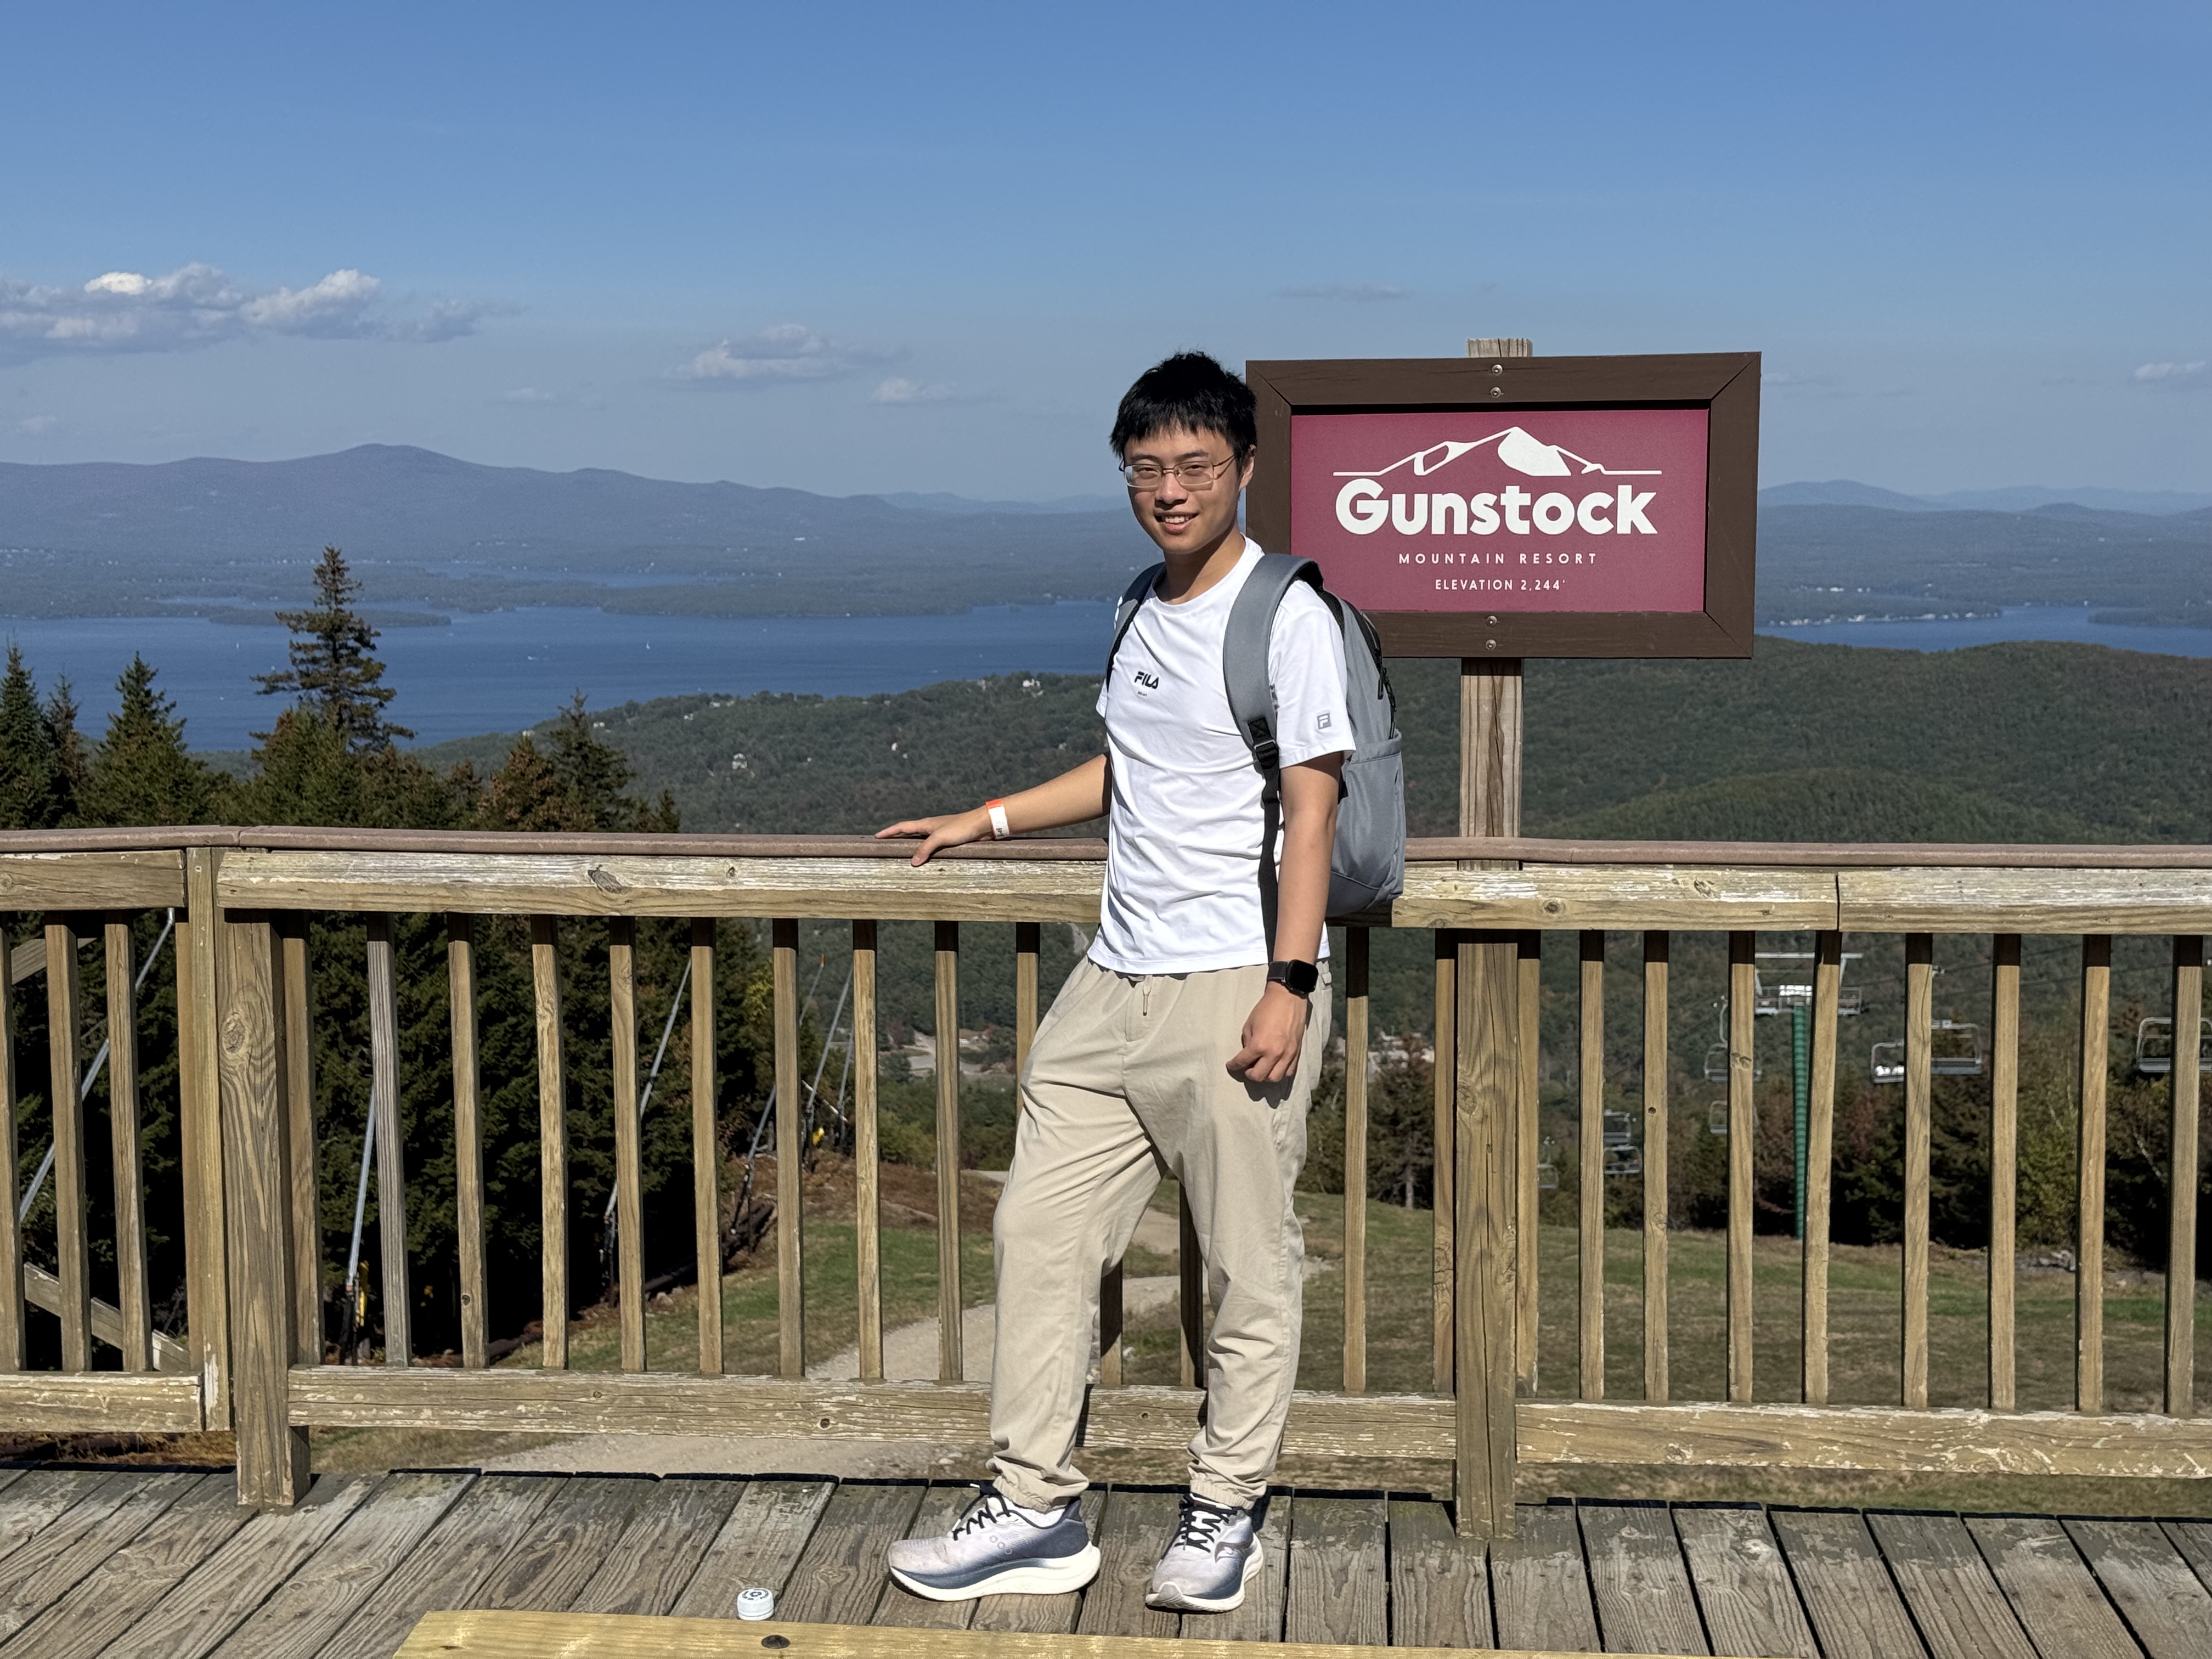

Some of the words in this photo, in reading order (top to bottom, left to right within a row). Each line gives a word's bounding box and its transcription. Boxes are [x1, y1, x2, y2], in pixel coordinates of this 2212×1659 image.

[1335, 478, 1658, 535] Gunstock
[1398, 552, 1504, 565] MOUNTAIN
[1519, 552, 1596, 565] RESORT
[1435, 579, 1513, 591] ELEVATION
[1134, 671, 1159, 689] FILA
